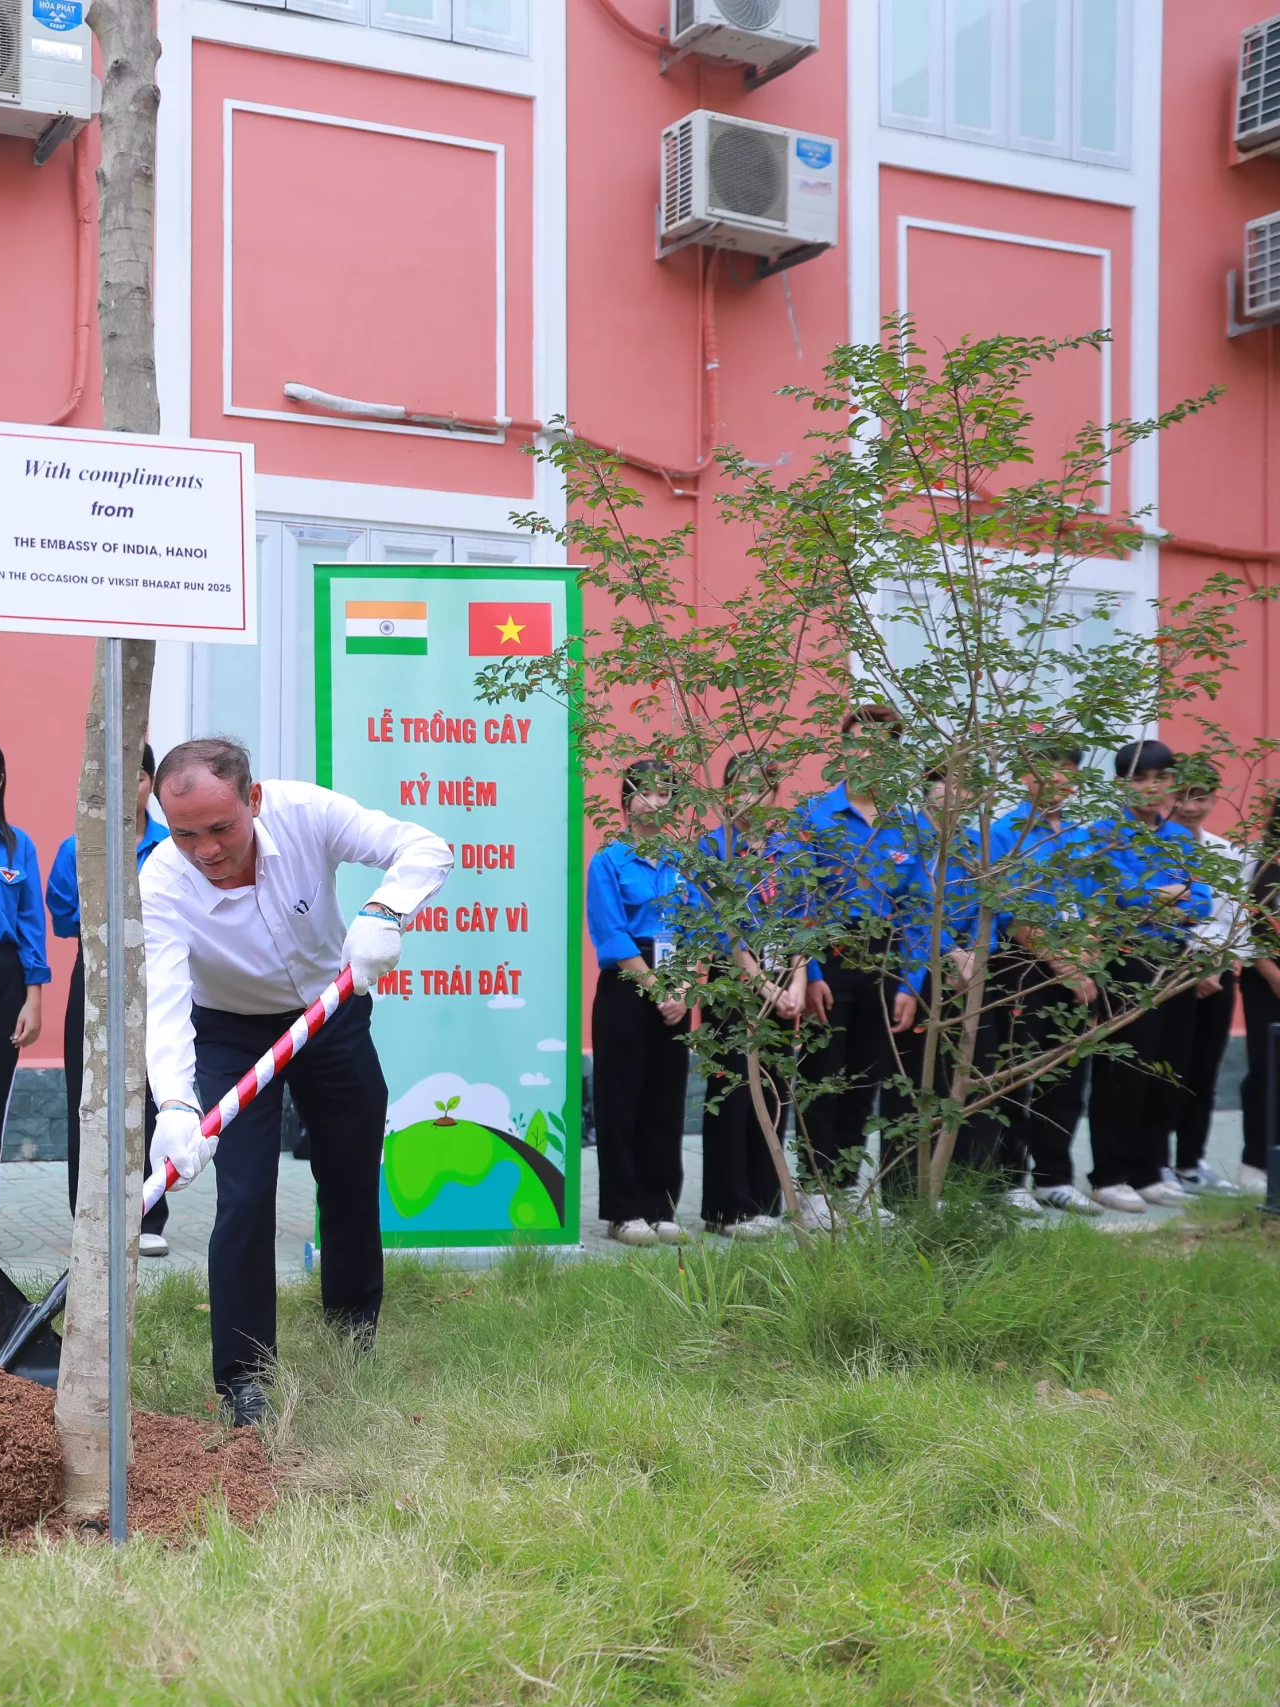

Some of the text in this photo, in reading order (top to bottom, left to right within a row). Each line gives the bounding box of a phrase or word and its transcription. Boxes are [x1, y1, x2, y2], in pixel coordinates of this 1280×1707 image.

[24, 459, 204, 490] With compliments
[91, 501, 134, 518] from
[13, 536, 208, 559] THE EMBASSY OF INDIA, HANOI
[9, 571, 27, 581] THE
[30, 572, 88, 585] OCCASION
[91, 576, 105, 586] OF
[108, 577, 139, 588] VIKSIT
[142, 579, 181, 590] BHARAT
[184, 581, 205, 592] RUN
[207, 583, 231, 593] 2025
[367, 708, 532, 744] LỄ TRỒNG CÂY
[400, 772, 497, 812] KỶ NIỆM
[461, 844, 516, 875] DỊCH
[455, 902, 499, 933] CÂY
[505, 901, 529, 933] VÌ
[377, 960, 522, 1001] MẸ TRÁI ĐẤT
